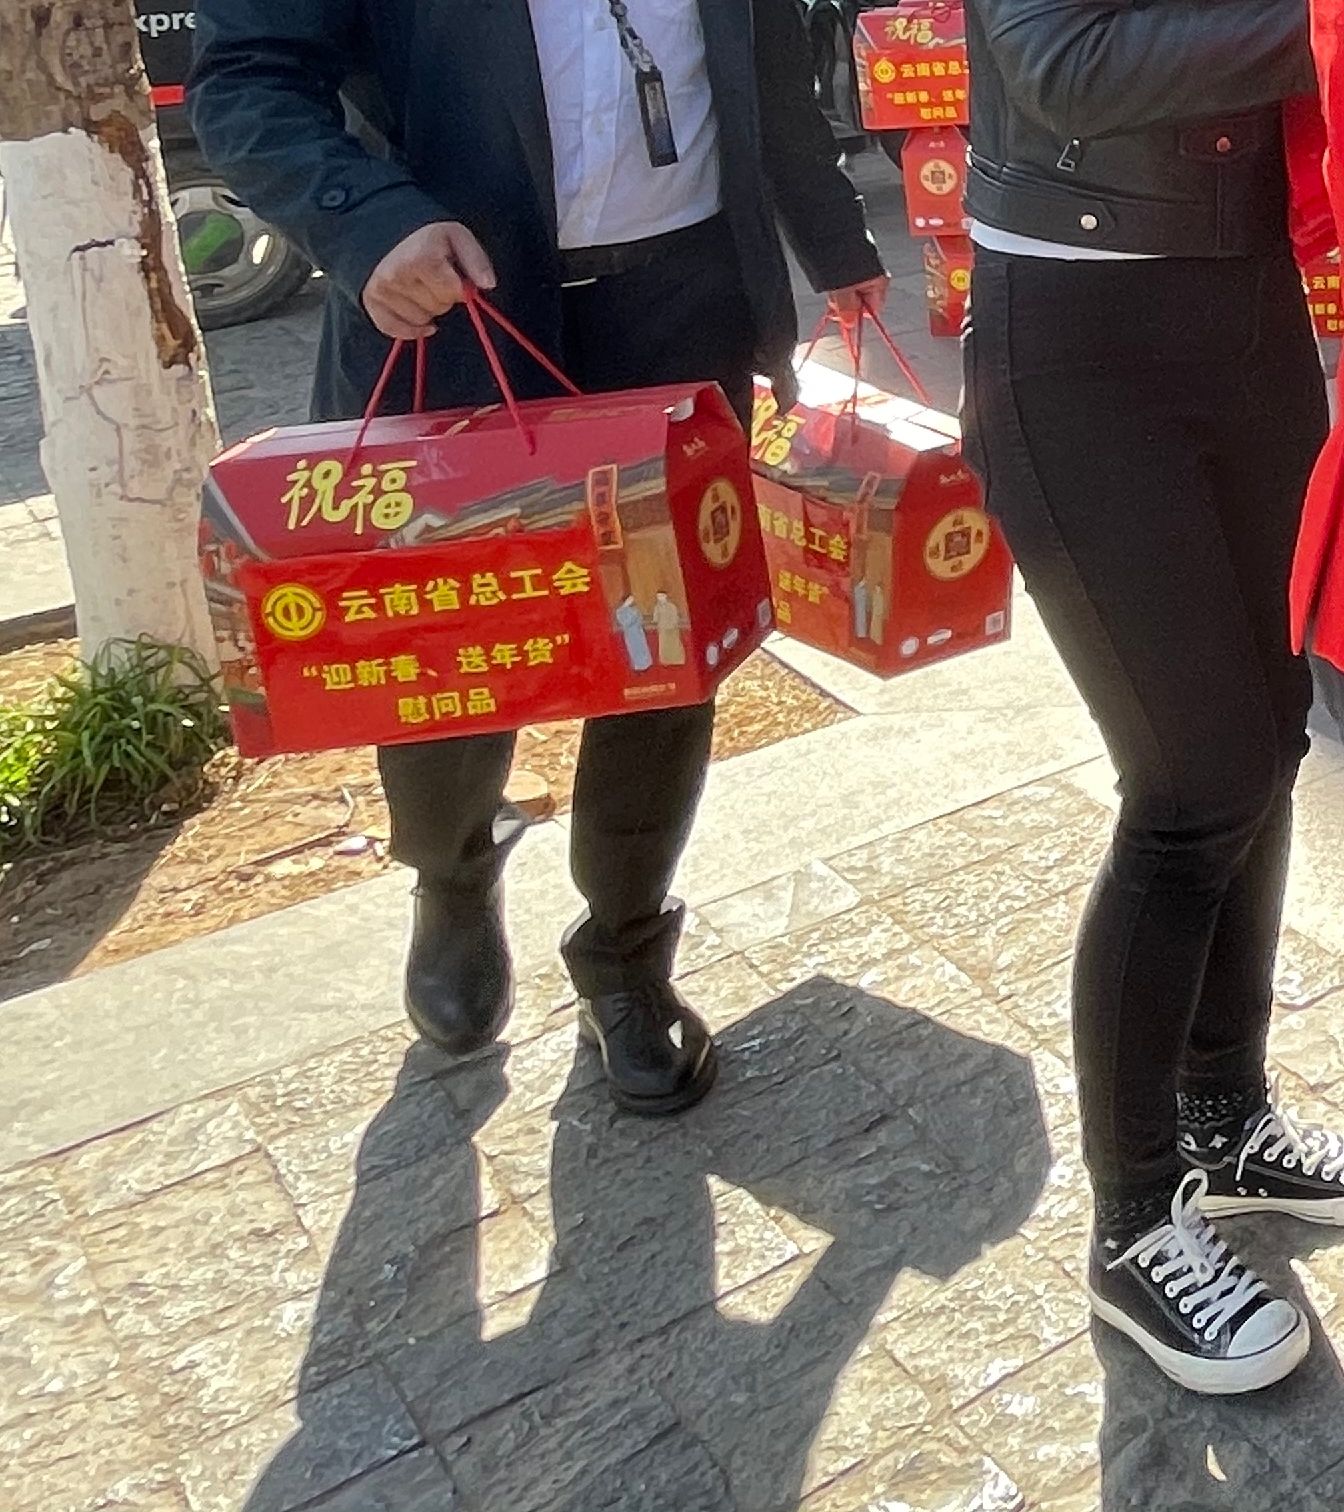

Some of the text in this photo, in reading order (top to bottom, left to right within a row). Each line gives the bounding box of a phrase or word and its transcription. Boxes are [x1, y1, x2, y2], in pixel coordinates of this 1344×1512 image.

[281, 458, 418, 535] 祝福
[337, 560, 592, 624] 云南省总工会
[398, 687, 497, 725] 慰问品
